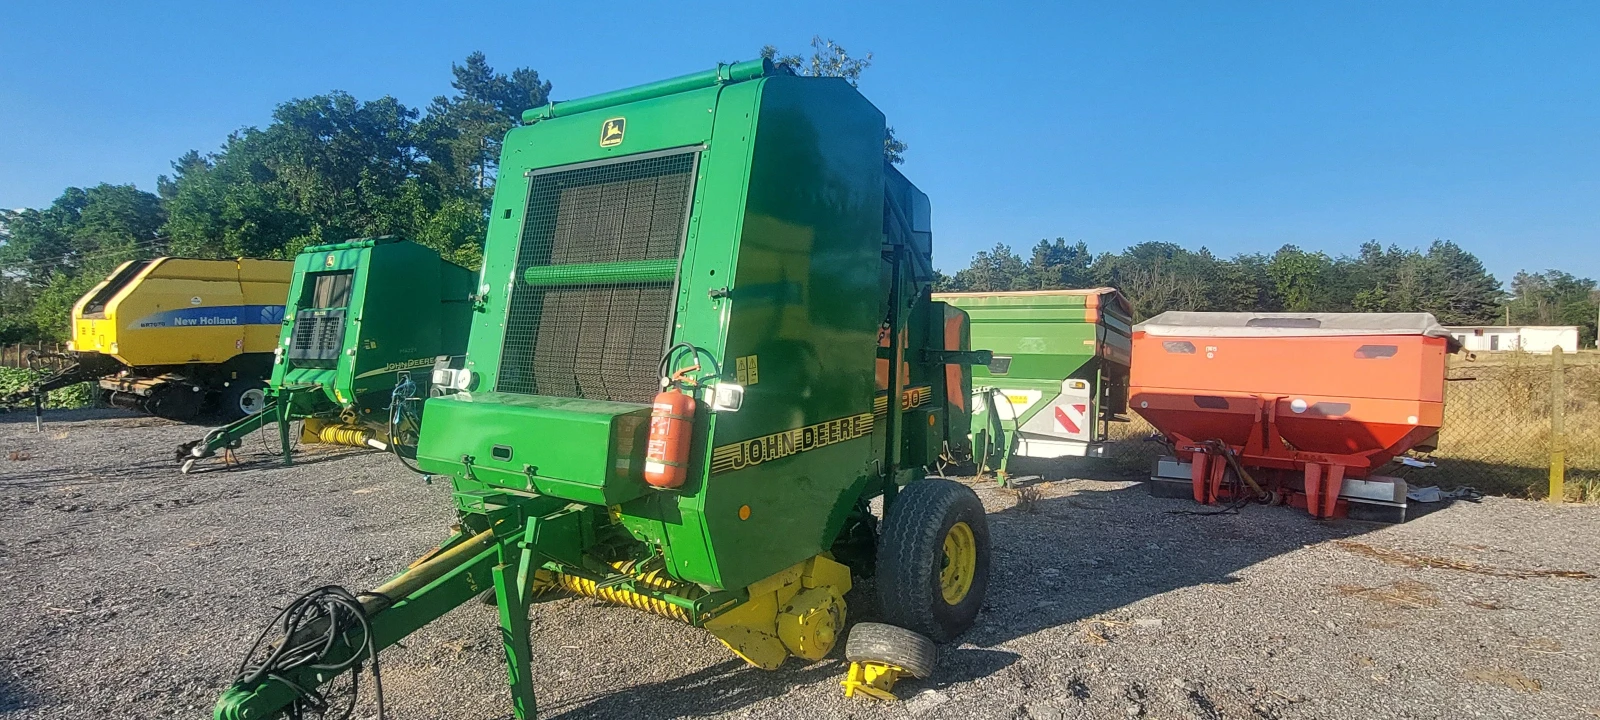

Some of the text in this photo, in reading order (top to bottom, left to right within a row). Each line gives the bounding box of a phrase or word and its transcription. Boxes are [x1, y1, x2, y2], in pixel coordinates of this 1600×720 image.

[174, 316, 238, 326] New Holland
[732, 415, 862, 470] JOHN DEERE
